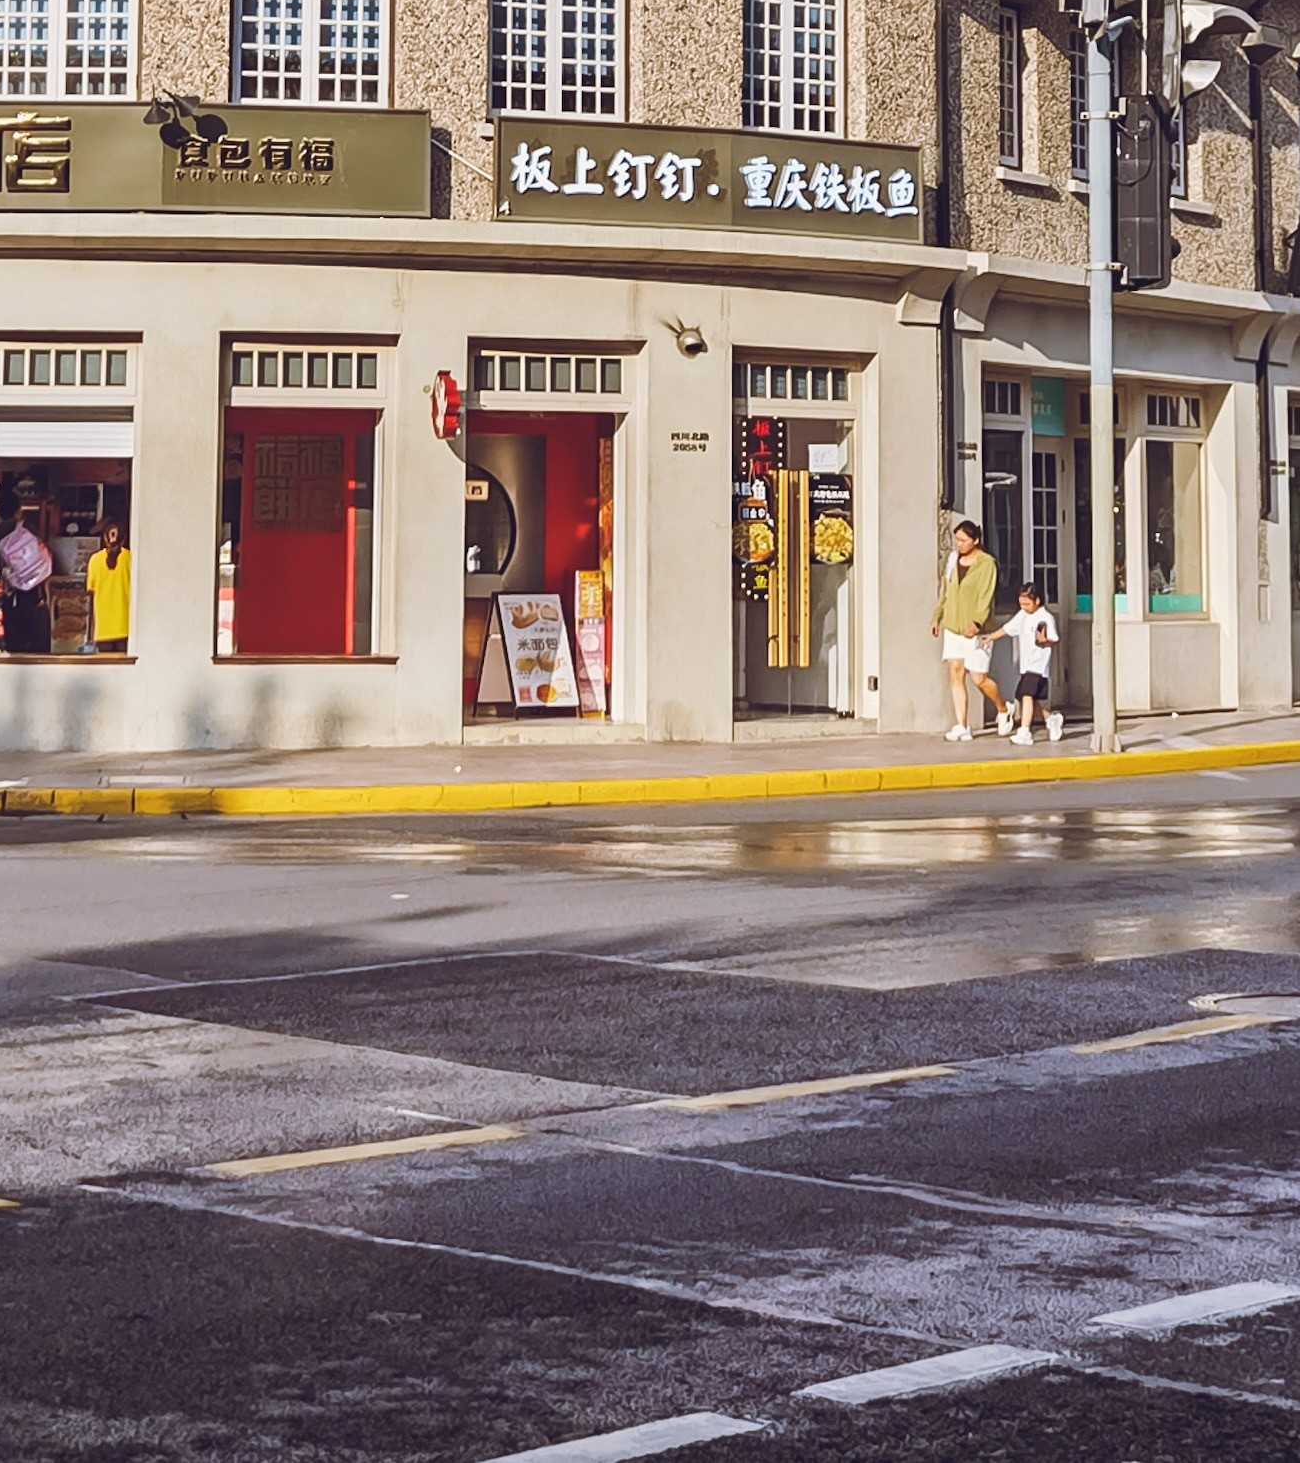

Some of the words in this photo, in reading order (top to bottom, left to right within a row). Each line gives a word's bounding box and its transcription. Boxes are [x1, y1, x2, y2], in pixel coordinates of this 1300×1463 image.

[738, 154, 919, 219] 重庆铁板鱼
